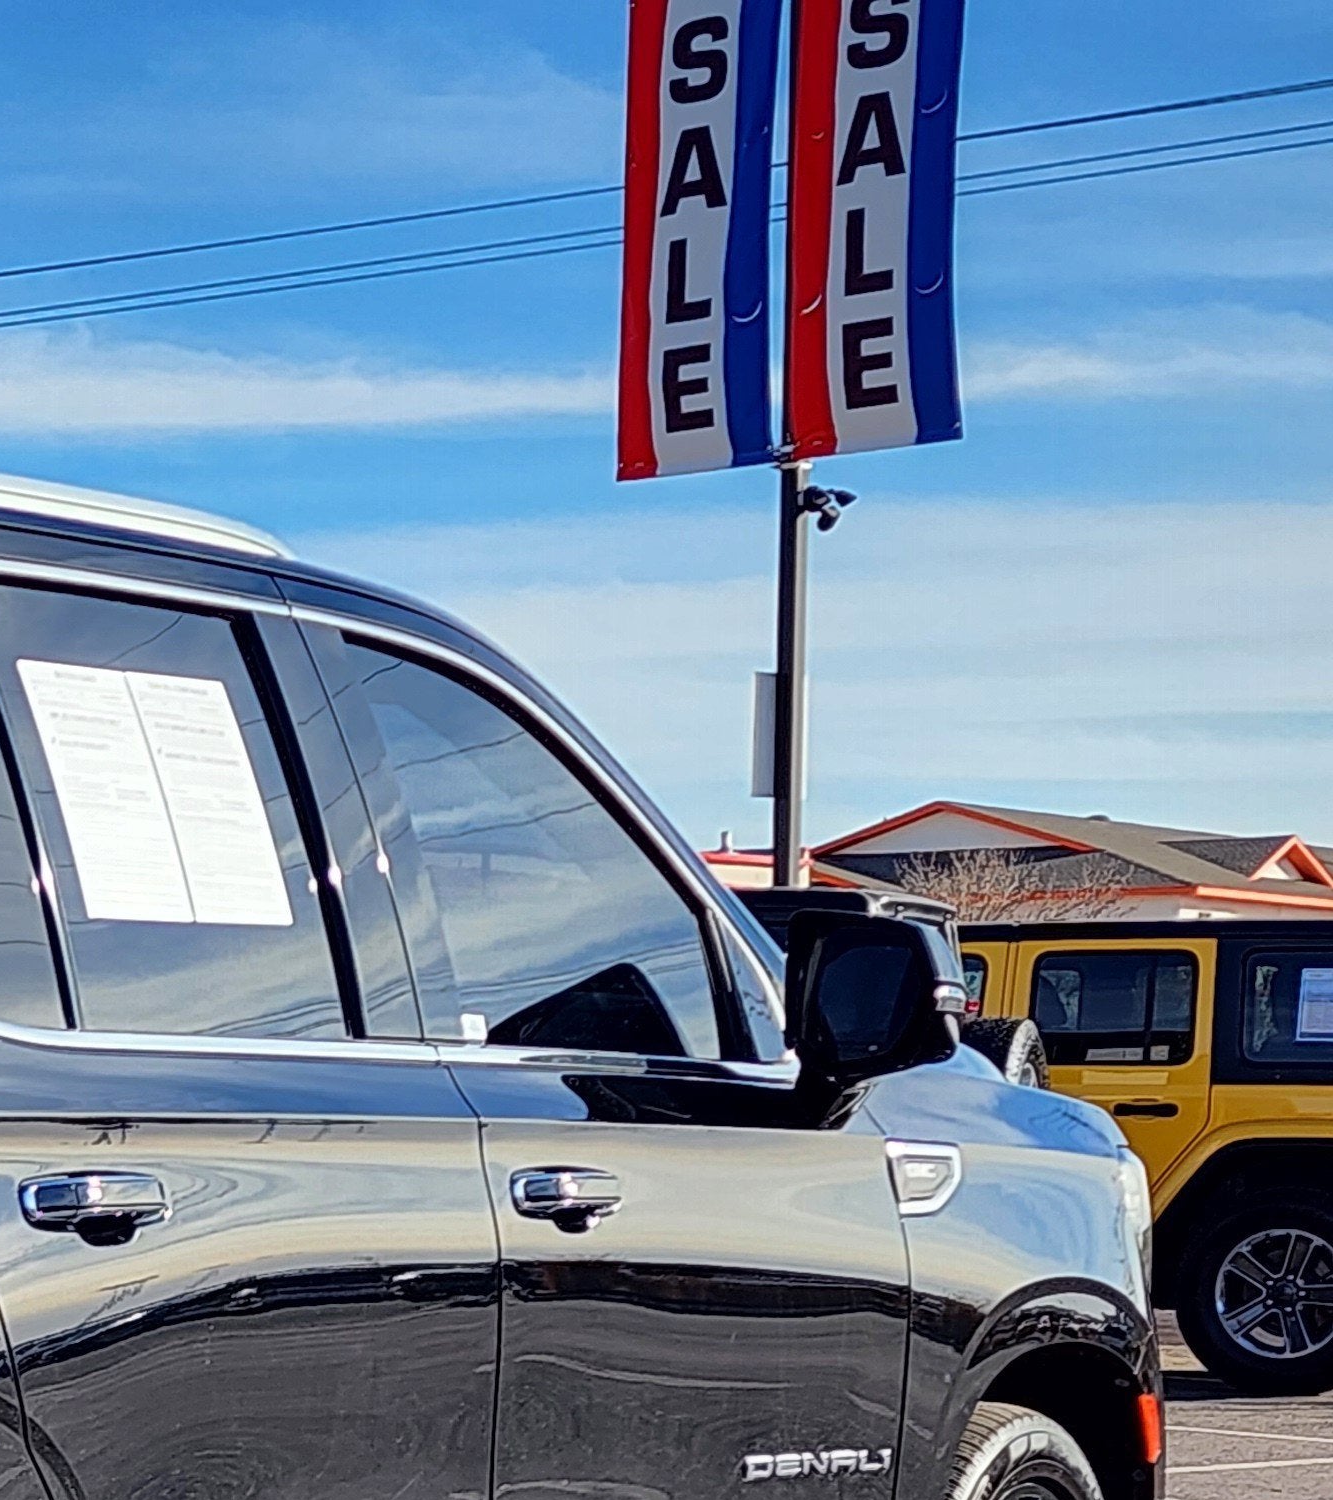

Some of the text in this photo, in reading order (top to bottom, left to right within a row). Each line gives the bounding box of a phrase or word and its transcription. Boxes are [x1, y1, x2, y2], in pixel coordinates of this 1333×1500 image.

[660, 15, 729, 434] SALE
[835, 0, 910, 410] SALE
[741, 1448, 892, 1483] DENALI
